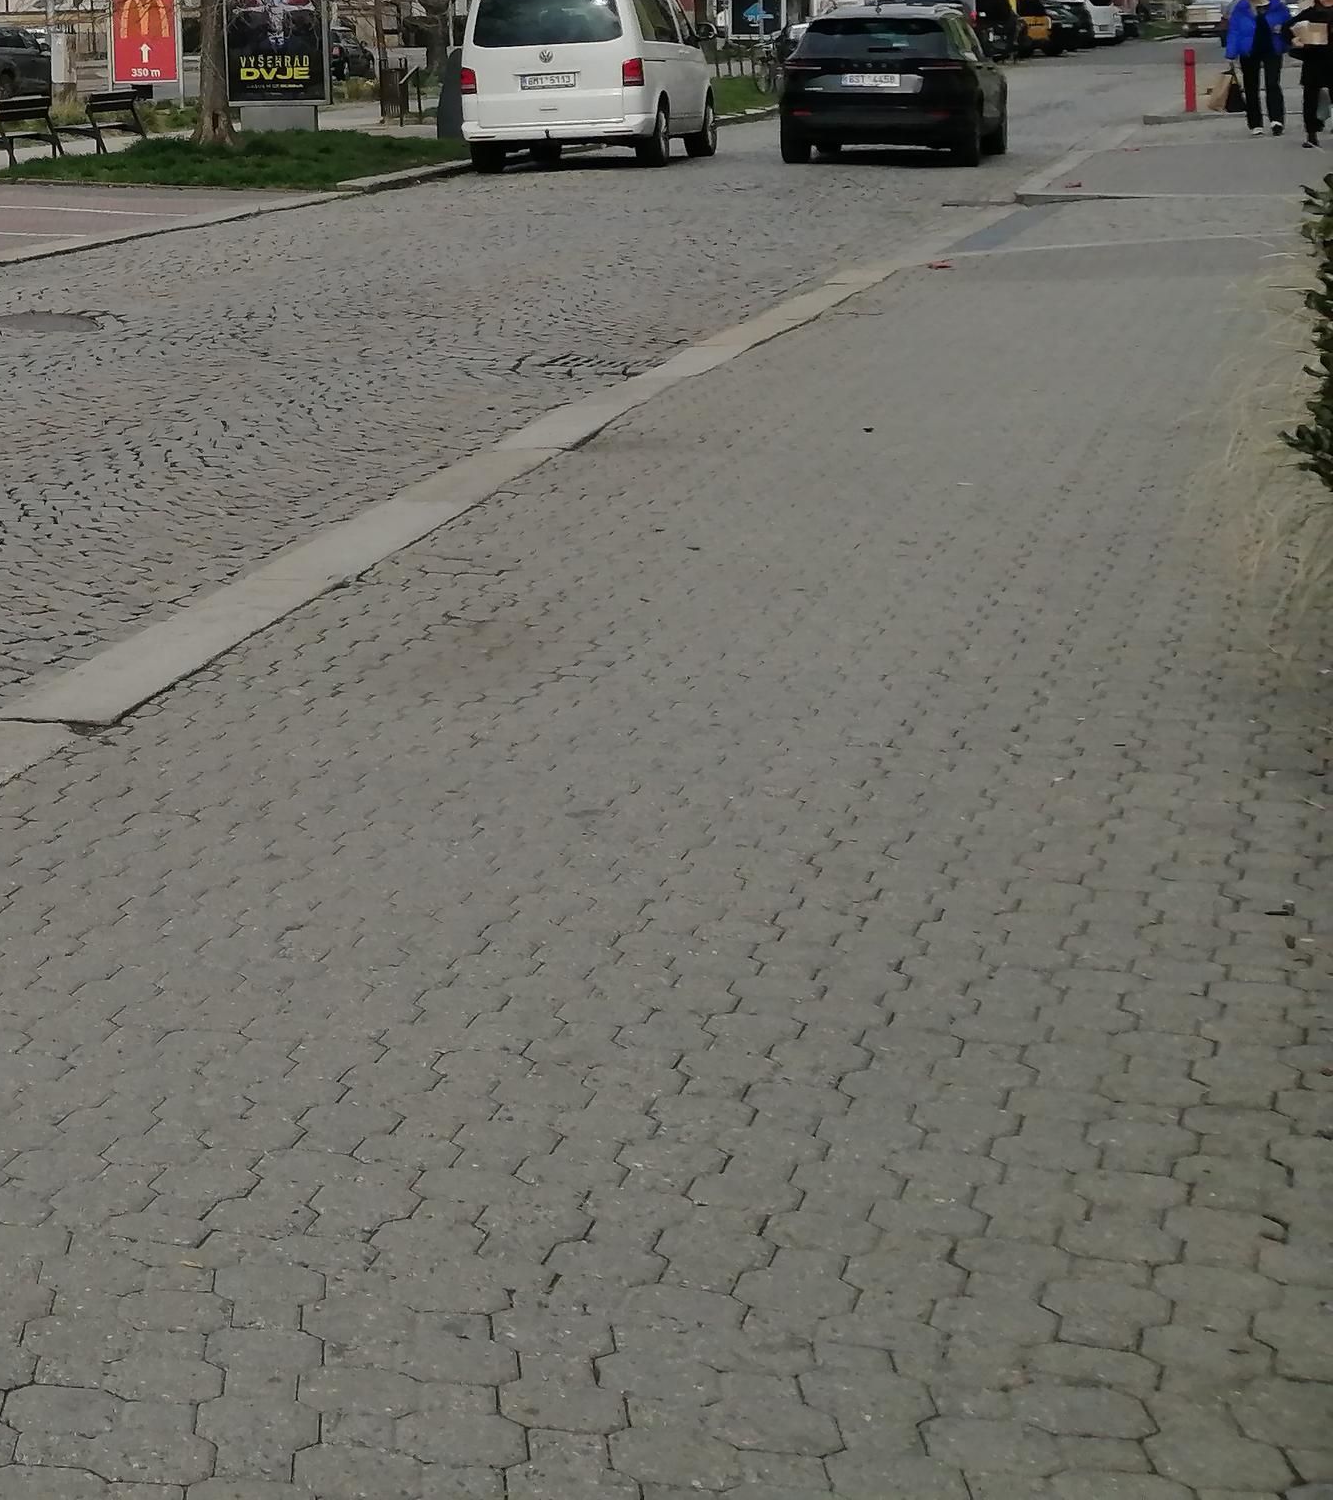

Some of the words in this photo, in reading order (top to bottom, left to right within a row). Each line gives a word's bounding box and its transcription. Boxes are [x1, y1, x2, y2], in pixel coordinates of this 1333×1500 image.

[131, 68, 149, 77] 350
[150, 69, 161, 77] m
[240, 68, 311, 80] DVJE
